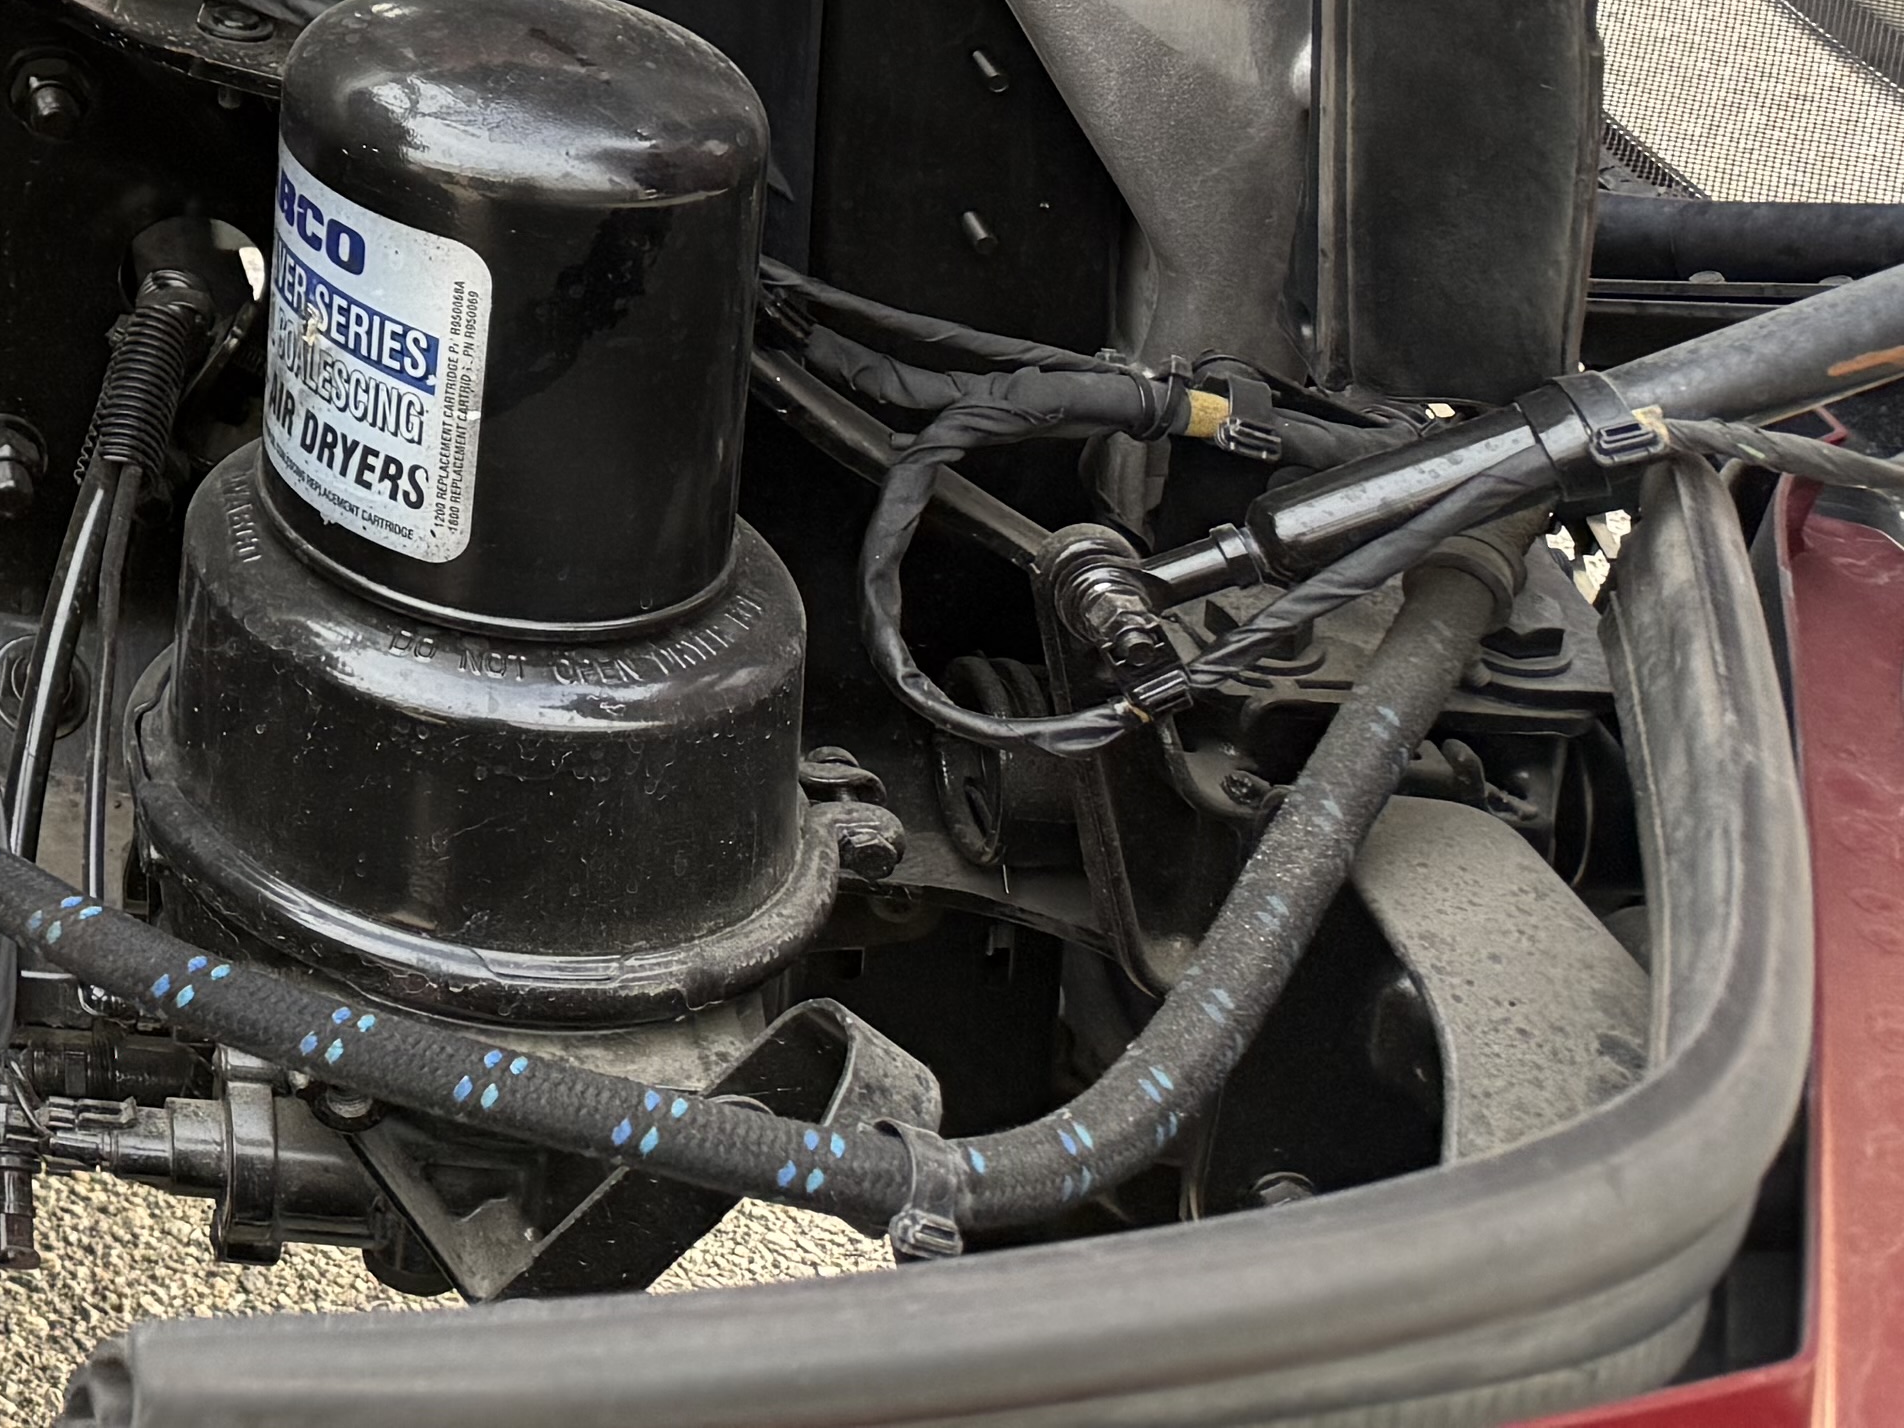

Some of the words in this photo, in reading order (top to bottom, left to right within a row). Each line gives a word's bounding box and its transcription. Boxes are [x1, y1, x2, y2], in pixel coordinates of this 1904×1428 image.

[280, 167, 366, 276] BCO
[277, 240, 307, 318] VER
[315, 283, 429, 379] SERIES
[444, 356, 459, 422] CARTRIDGE
[269, 374, 296, 437] AIR
[300, 408, 429, 510] DRYERS
[436, 423, 454, 504] REPLACEMENT
[450, 424, 467, 505] REPLACEMENT
[459, 359, 475, 422] CARTRID
[305, 473, 360, 518] REPLACEMENT
[361, 509, 414, 540] CARTRIDGE
[435, 505, 446, 528] 1200
[388, 628, 437, 663] DO
[457, 649, 526, 681] NOT
[552, 652, 642, 685] OPEN
